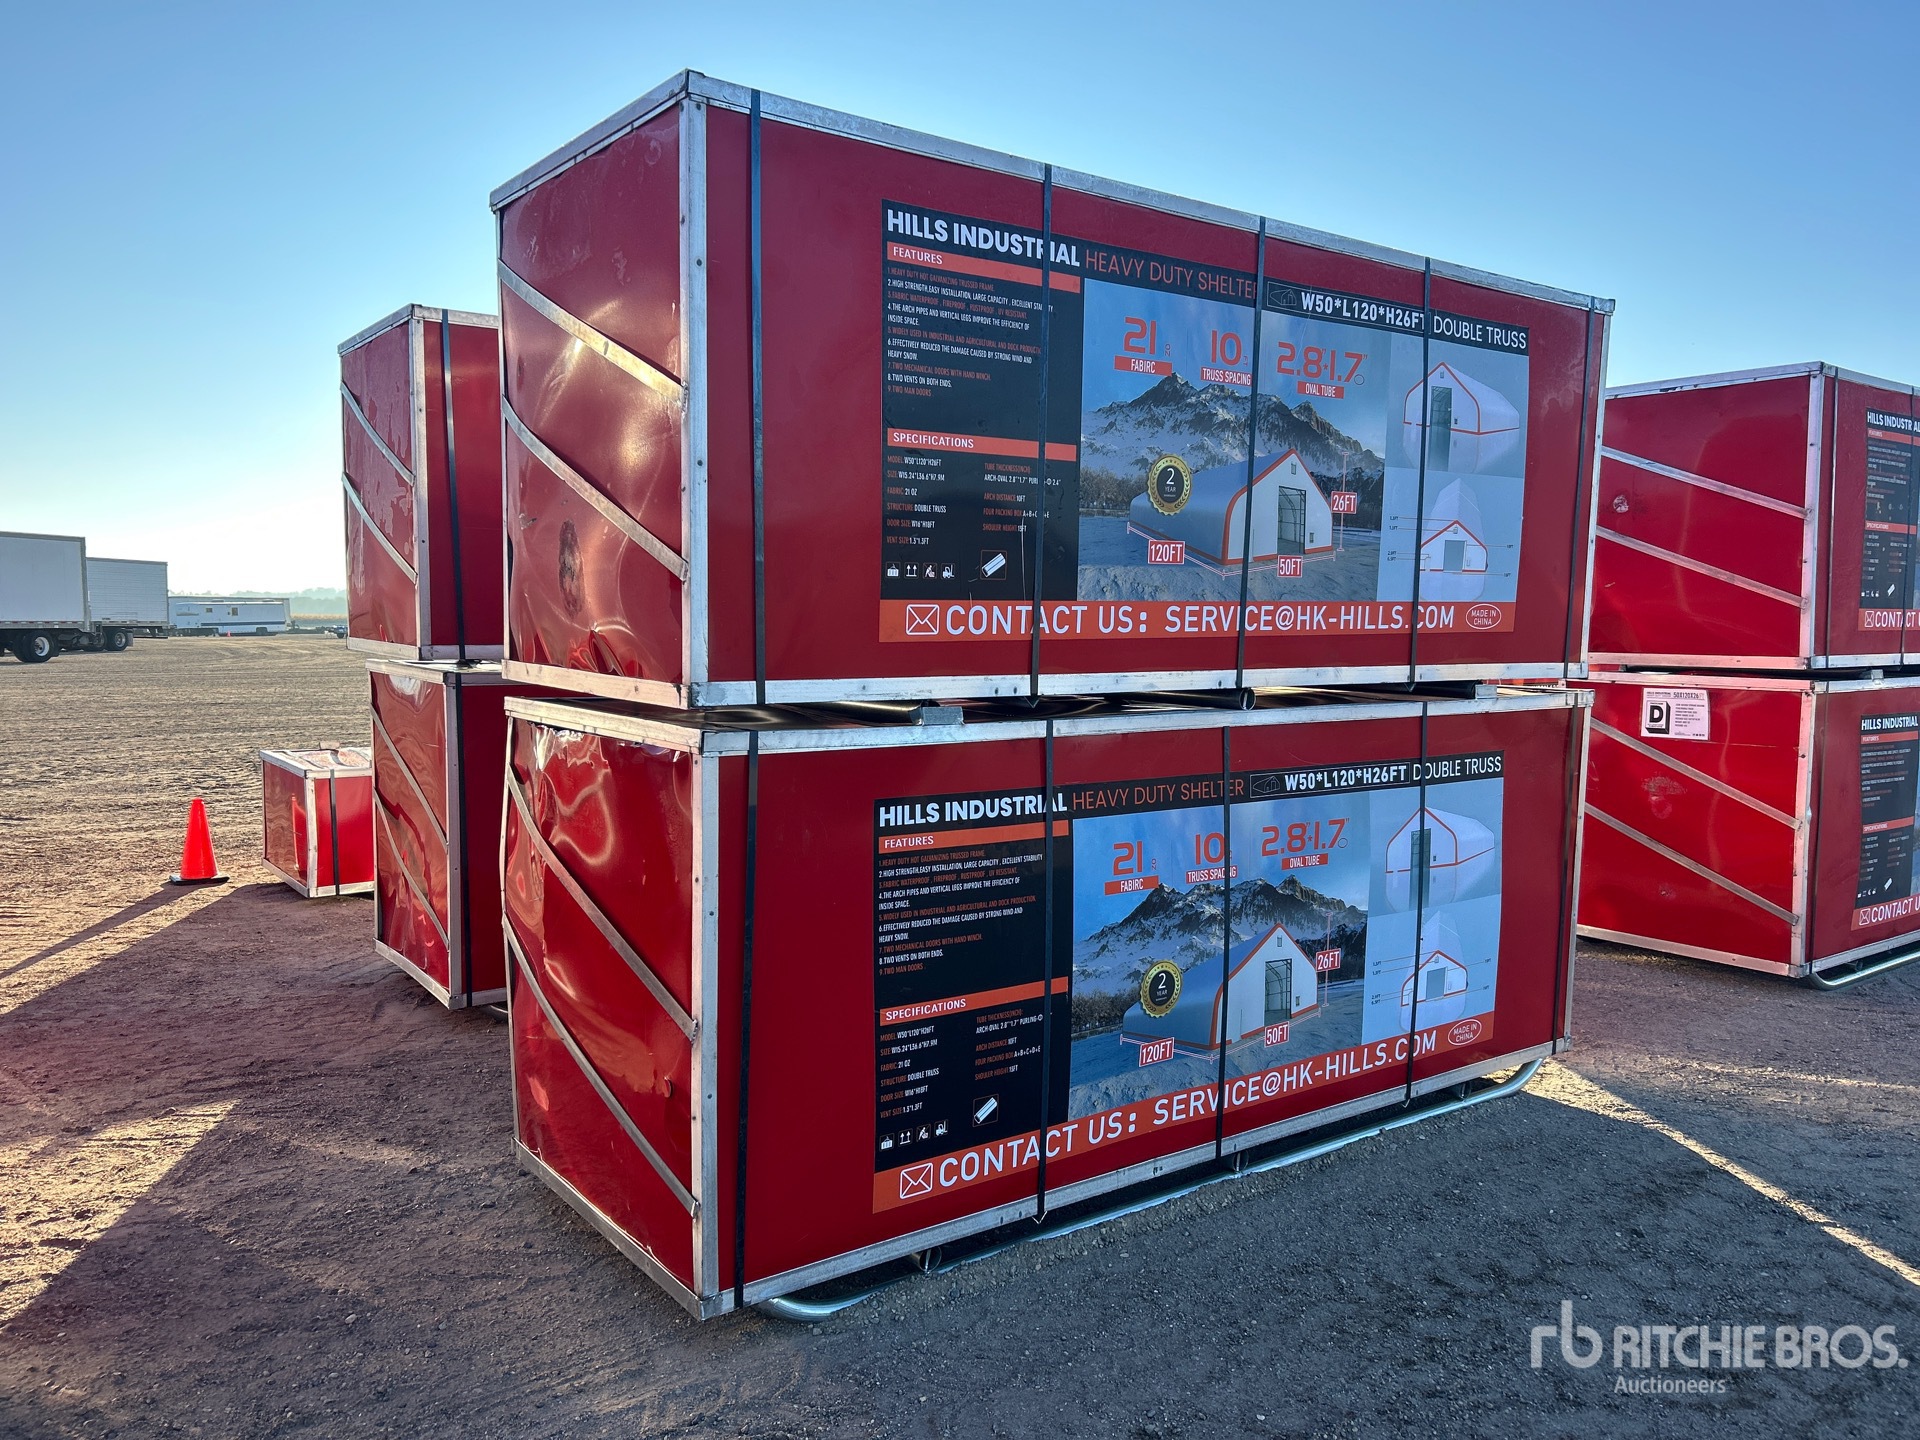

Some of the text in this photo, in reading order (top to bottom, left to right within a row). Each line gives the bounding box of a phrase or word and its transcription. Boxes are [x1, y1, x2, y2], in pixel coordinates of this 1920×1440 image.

[887, 209, 948, 242] HILLS
[954, 223, 1080, 266] INDUSTRIAL
[1086, 249, 1144, 278] HEAVY
[1150, 262, 1193, 287] DUTY
[893, 247, 942, 265] FEATURES
[972, 292, 986, 302] LARGE
[887, 314, 903, 324] INSIDE
[901, 305, 915, 315] ARCH
[915, 307, 928, 317] PIPES
[929, 309, 938, 318] AND
[992, 318, 1000, 327] THE
[1124, 317, 1156, 354] 21
[1434, 316, 1482, 341] DOUBLE
[1486, 327, 1526, 349] TRUSS
[887, 350, 902, 359] HEAVY
[920, 343, 940, 353] REDUCED
[941, 345, 949, 354] THE
[950, 346, 969, 356] DAMAGE
[969, 349, 986, 358] CAUSED
[1211, 330, 1241, 366] 10
[1131, 359, 1156, 373] FABIRC
[903, 375, 918, 384] VENTS
[918, 377, 925, 385] ON
[926, 377, 938, 386] BOTH
[1203, 368, 1250, 386] TRUSS SPACING
[1305, 383, 1336, 397] OVAL TUBE
[1868, 412, 1920, 432] HILLS INDUSTRAL
[894, 432, 974, 448] SPECIFICATIONS
[1166, 468, 1175, 485] 2
[914, 505, 946, 513] DOUBLE TRUSS
[1333, 494, 1356, 511] 26FT
[1150, 543, 1183, 562] 120FT
[1280, 559, 1301, 576] 50FT
[946, 605, 1454, 635] CONTACT US: SERVICE@HK-HILLS.COM
[1649, 705, 1663, 723] D
[1862, 716, 1918, 730] HILLS INDUSTRIAL
[1413, 760, 1461, 781] DOUBLE
[1465, 756, 1502, 774] TRUSS
[880, 803, 939, 827] HILLS
[1074, 788, 1129, 810] HEAVY
[1134, 784, 1176, 805] DUTY
[1181, 779, 1244, 800] SHELTER
[885, 835, 934, 848] FEATURES
[1195, 832, 1225, 865] 10
[963, 861, 977, 869] LARGE
[1113, 841, 1142, 876] 21
[1290, 855, 1319, 868] OVAL TUBE
[1188, 866, 1236, 882] TRUSS SPACNG
[892, 890, 905, 898] ARCH
[906, 888, 919, 897] PIPES
[920, 887, 930, 895] AND
[983, 880, 991, 888] THE
[1121, 879, 1143, 892] FABIRC
[878, 902, 894, 911] INSIDE
[1872, 898, 1913, 922] CONTACT
[911, 918, 931, 928] REDUCED
[932, 917, 940, 925] THE
[941, 915, 960, 924] DAMAGE
[960, 912, 978, 922] CAUSED
[878, 935, 892, 943] HEAVY
[894, 954, 909, 963] VENTS
[910, 953, 916, 961] ON
[917, 951, 930, 960] BOTH
[1318, 951, 1340, 968] 26FT
[1158, 973, 1166, 989] 2
[886, 999, 966, 1020] SPECIFICATIONS
[1266, 1024, 1288, 1044] 50FT
[1454, 1025, 1470, 1035] MADE
[1456, 1032, 1473, 1042] CHINA
[1141, 1041, 1172, 1063] 120FT
[907, 1068, 939, 1082] DOUBLE TRUSS
[939, 1030, 1437, 1187] CONTACT US: SERVICE@HK-HILLS.COM
